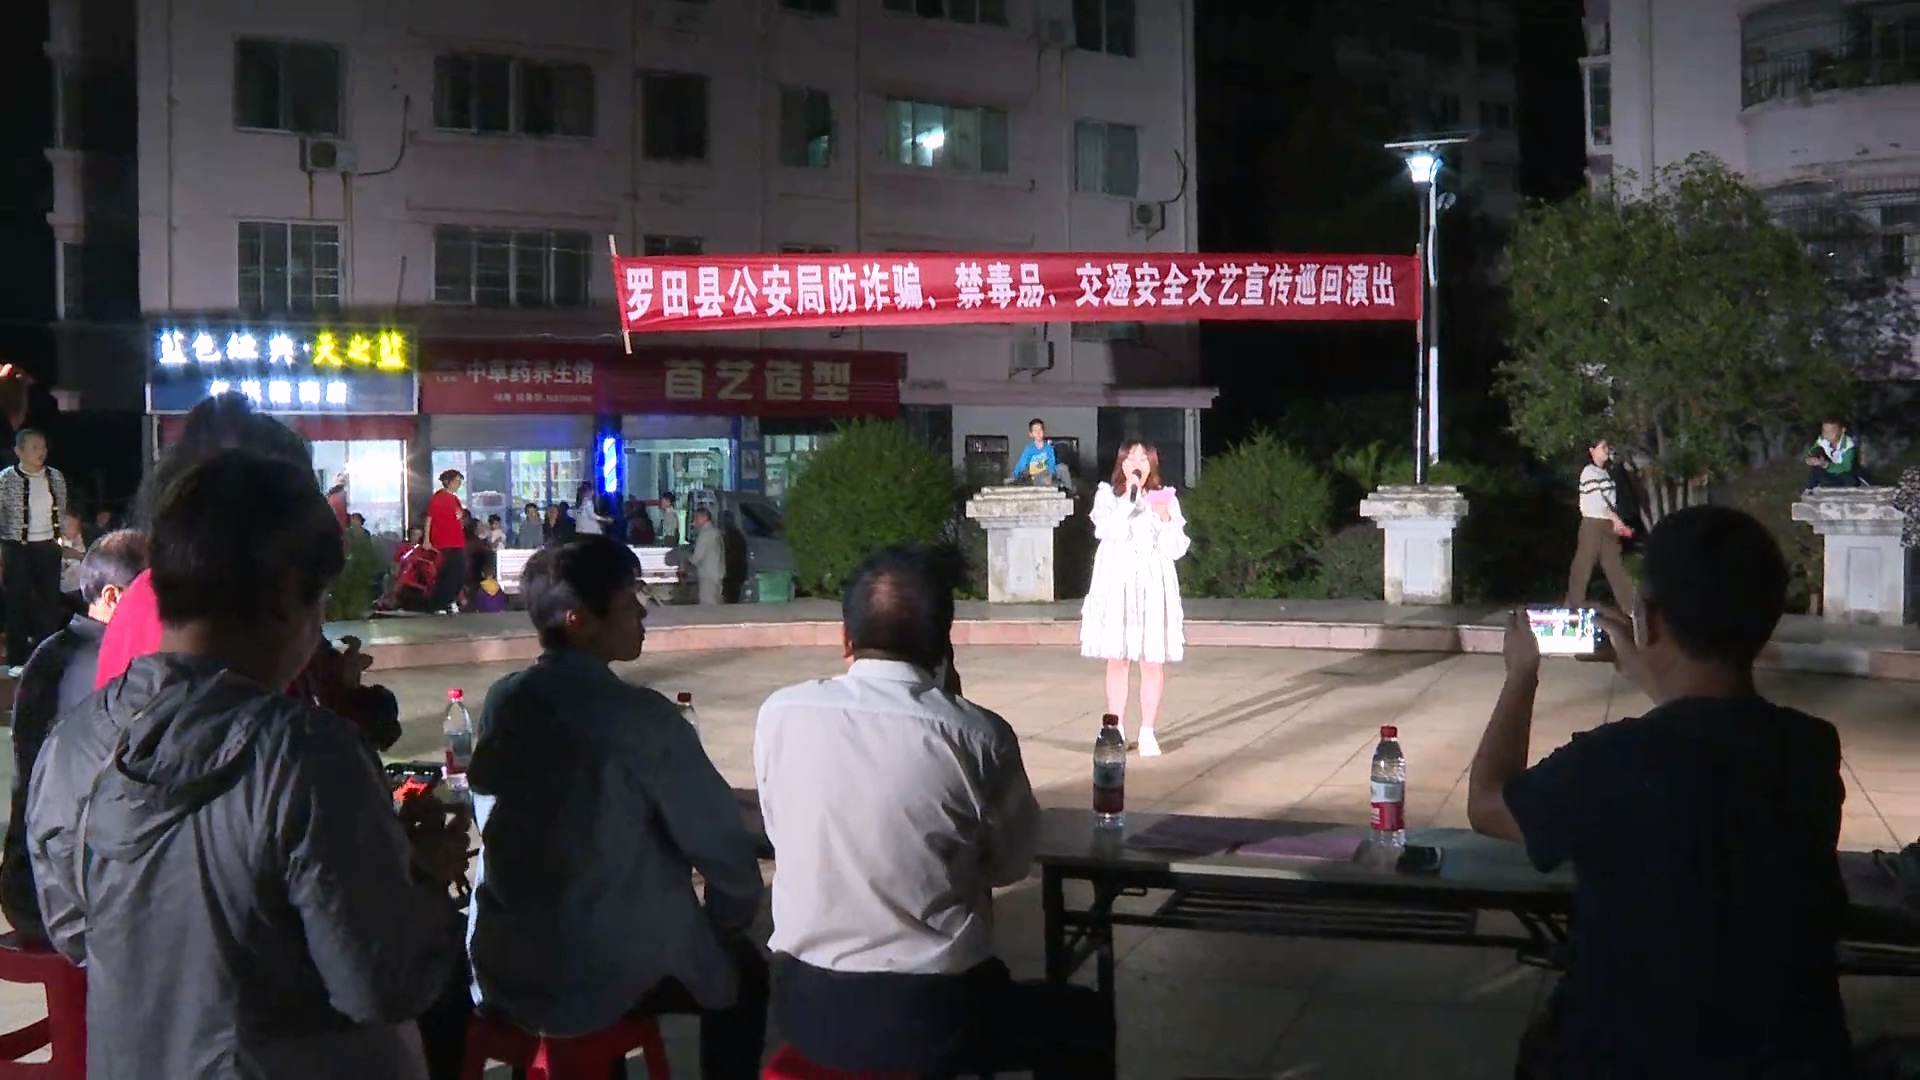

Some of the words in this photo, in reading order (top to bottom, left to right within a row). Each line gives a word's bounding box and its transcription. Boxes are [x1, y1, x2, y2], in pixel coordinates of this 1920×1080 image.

[625, 260, 1396, 321] 罗田县公安局防诈骗、禁毒品、交通安全文艺宣传巡回演出
